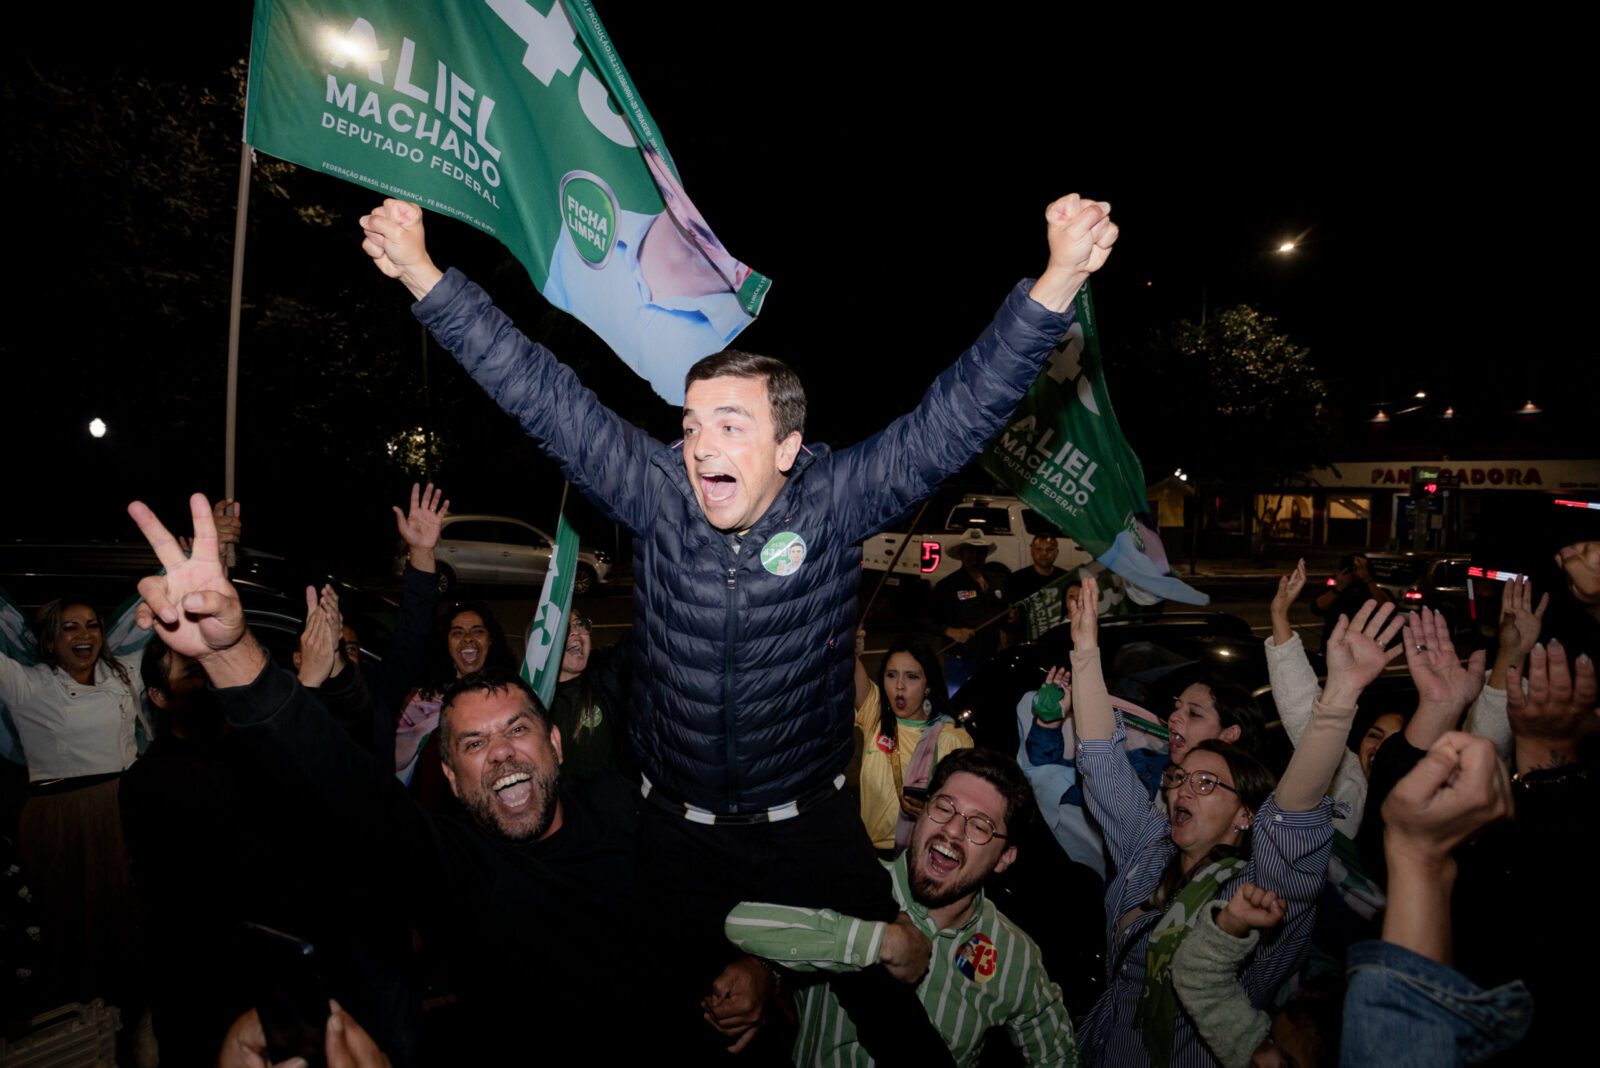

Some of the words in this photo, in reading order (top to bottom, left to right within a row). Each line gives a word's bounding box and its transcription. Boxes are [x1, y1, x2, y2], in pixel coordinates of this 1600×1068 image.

[329, 16, 501, 162] ALIEL
[321, 112, 424, 163] DEPUTADO
[430, 156, 500, 209] FEDERAL
[325, 74, 501, 188] MACHADO
[322, 161, 359, 180] FEDERAÇÃO
[359, 174, 379, 189] BRASIL
[380, 181, 389, 190] DA
[389, 185, 423, 203] ESPERANÇA
[567, 194, 607, 235] FICHA
[1000, 431, 1090, 506] MACHADO
[1010, 414, 1099, 493] ALIEL
[1038, 482, 1079, 518] FEDERAL
[972, 944, 998, 977] 13
